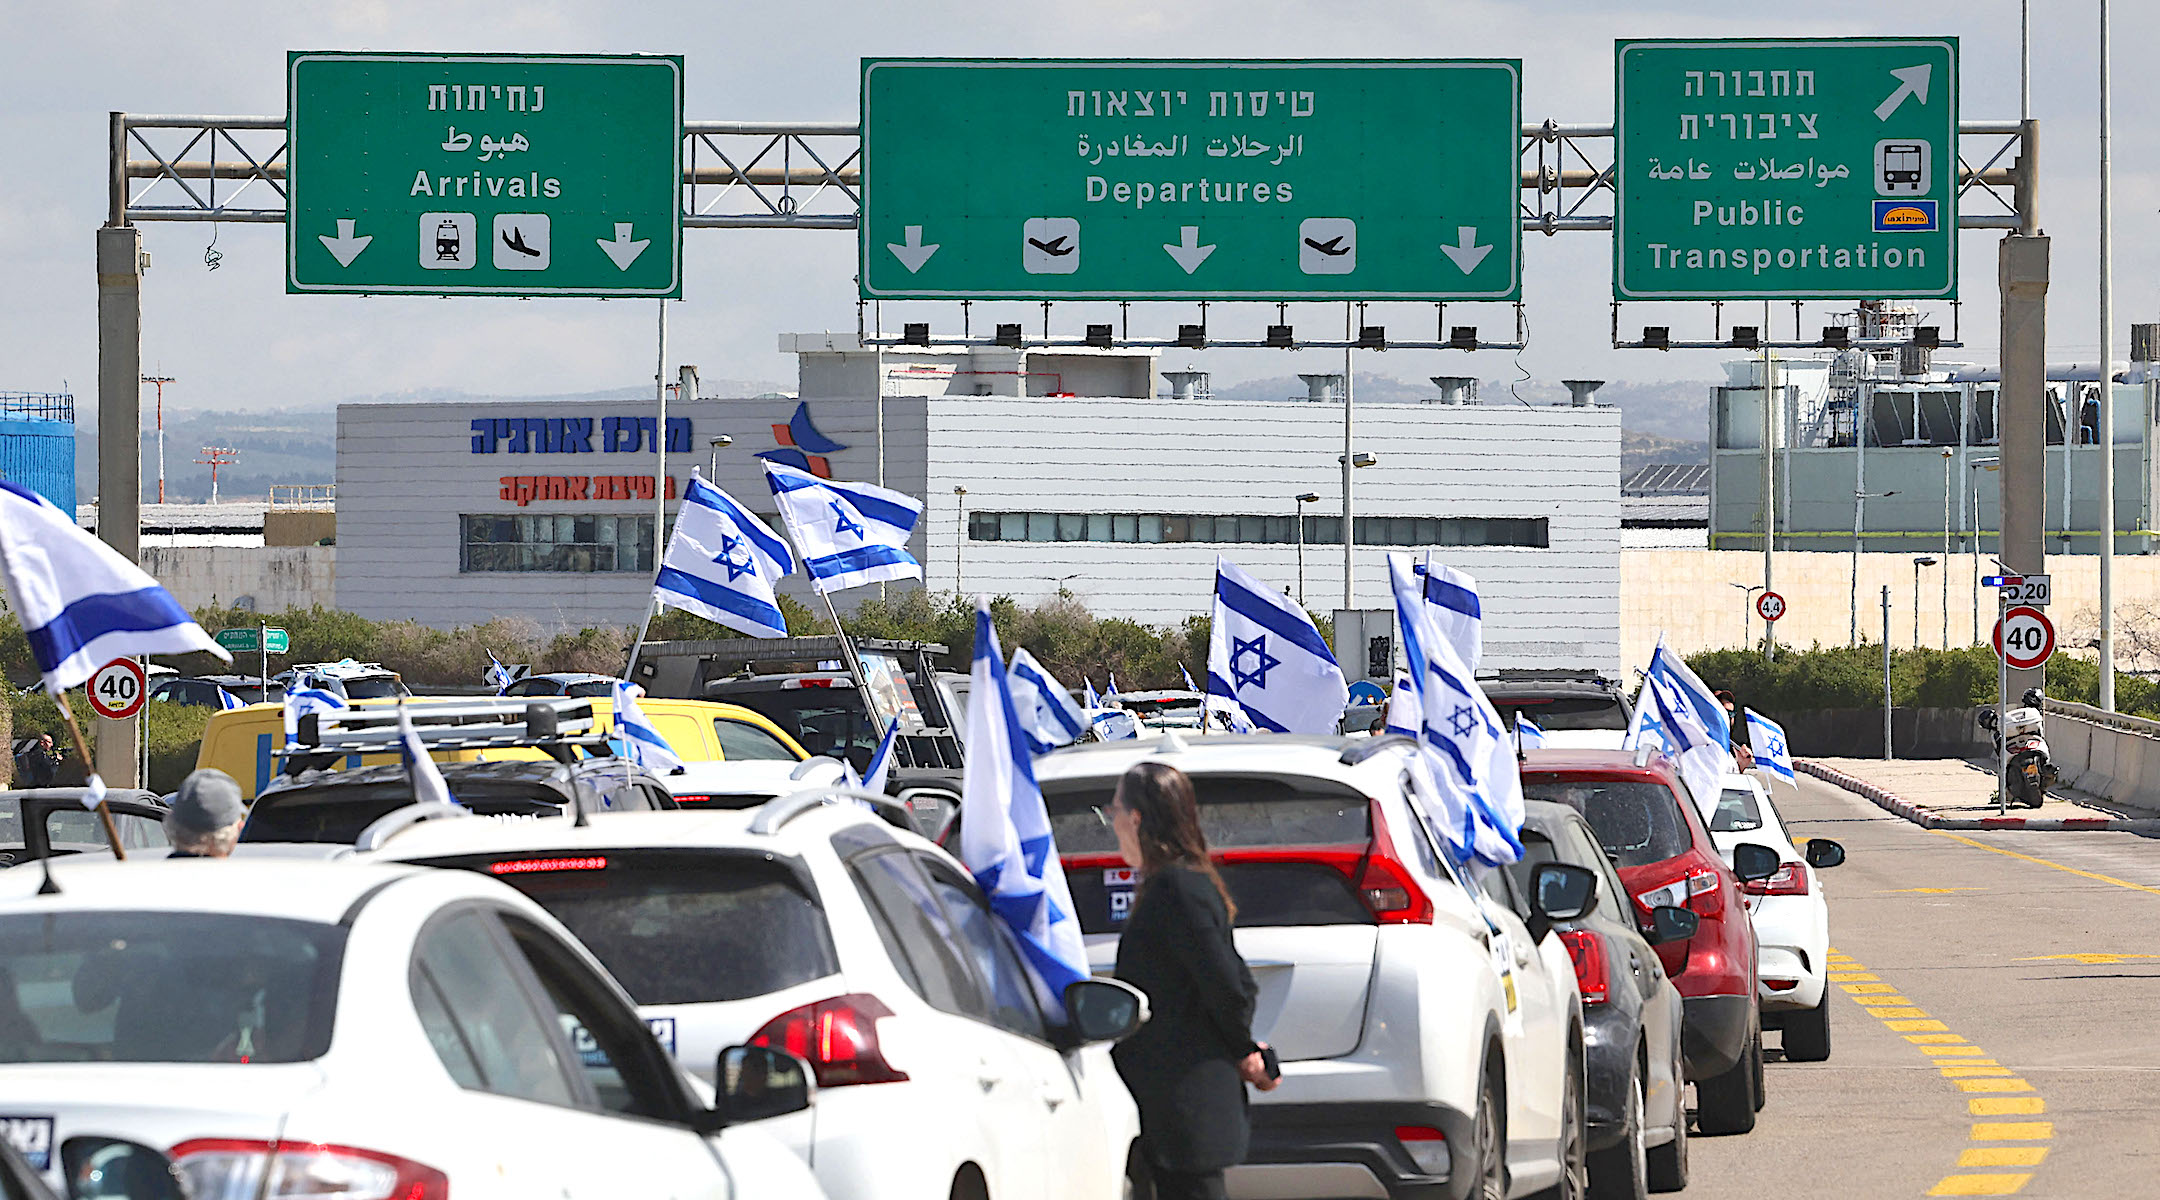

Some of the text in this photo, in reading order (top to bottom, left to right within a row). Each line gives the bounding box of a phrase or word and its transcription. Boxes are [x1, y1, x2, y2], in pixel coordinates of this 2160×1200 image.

[428, 84, 545, 112] נחיתות
[1685, 71, 1815, 97] תחבורה
[1067, 91, 1315, 117] טיסות יוצאות
[1680, 113, 1818, 140] ציבורית
[441, 126, 530, 162] هبوط
[1078, 133, 1304, 166] الرحلات المغادرة
[410, 170, 562, 198] Arrivals
[1648, 157, 1850, 188] مواصلات عامة
[1086, 177, 1294, 210] Departures
[1693, 200, 1805, 226] Public
[1648, 242, 1927, 275] Transportation
[471, 417, 693, 454] מרכז אנרגיה
[500, 476, 589, 507] אחזקה
[1762, 601, 1780, 613] 4.4
[2006, 627, 2042, 651] 40
[100, 675, 136, 700] 40
